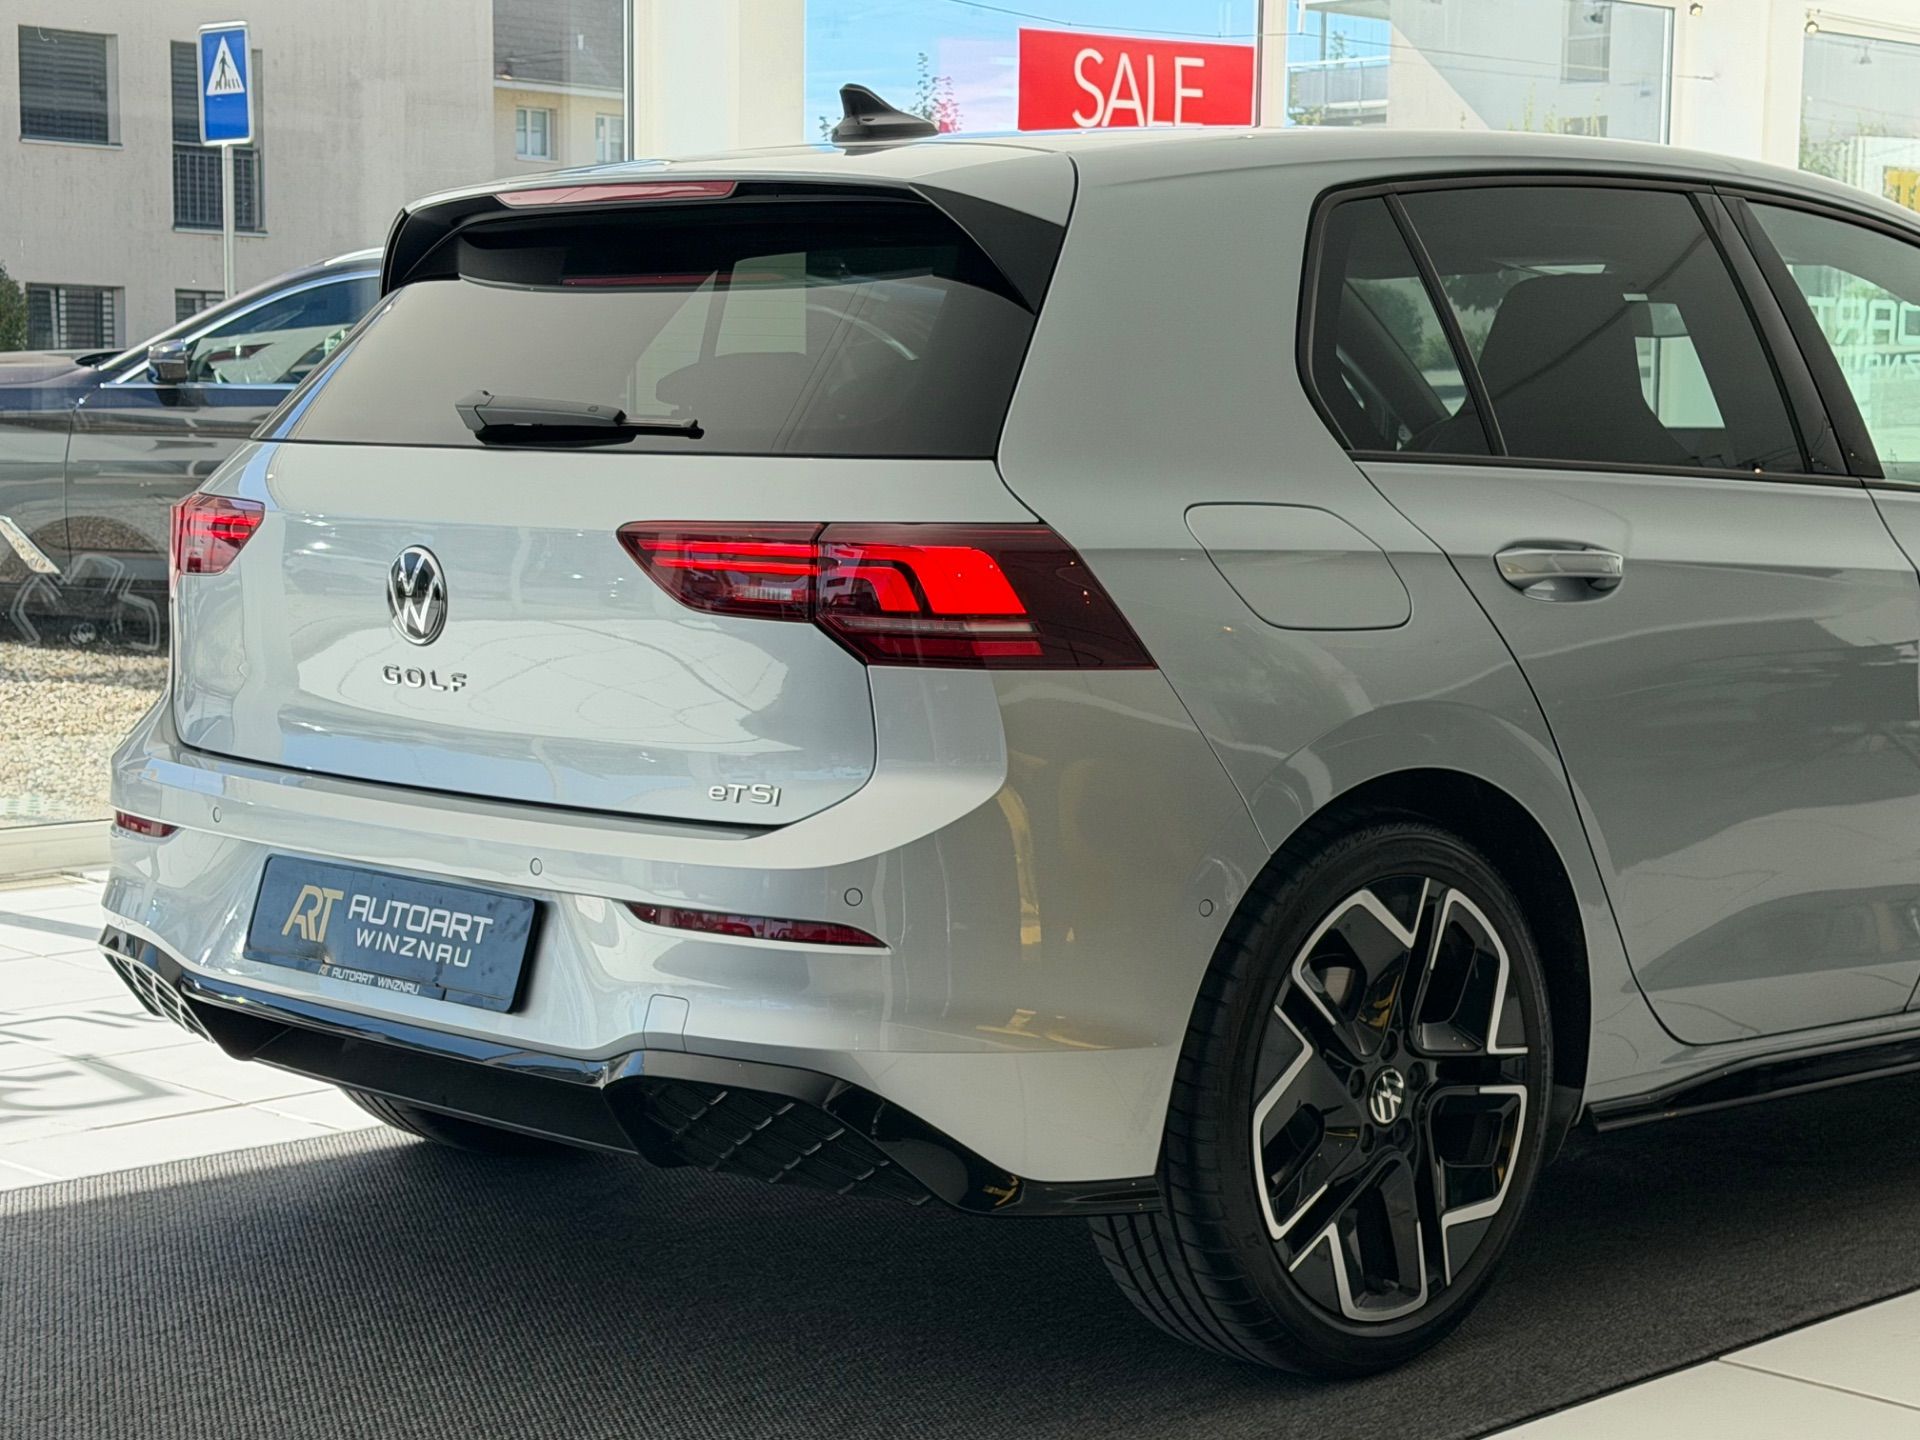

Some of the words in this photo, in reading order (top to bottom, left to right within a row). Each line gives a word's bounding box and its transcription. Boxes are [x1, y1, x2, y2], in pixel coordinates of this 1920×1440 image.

[1072, 48, 1205, 128] SALE
[382, 664, 468, 693] GOLF
[708, 783, 782, 807] eTSI
[347, 894, 494, 945] AUTOART
[356, 927, 472, 968] WINZNAU
[331, 966, 375, 985] AUTOART
[377, 976, 420, 995] WINZNAU
